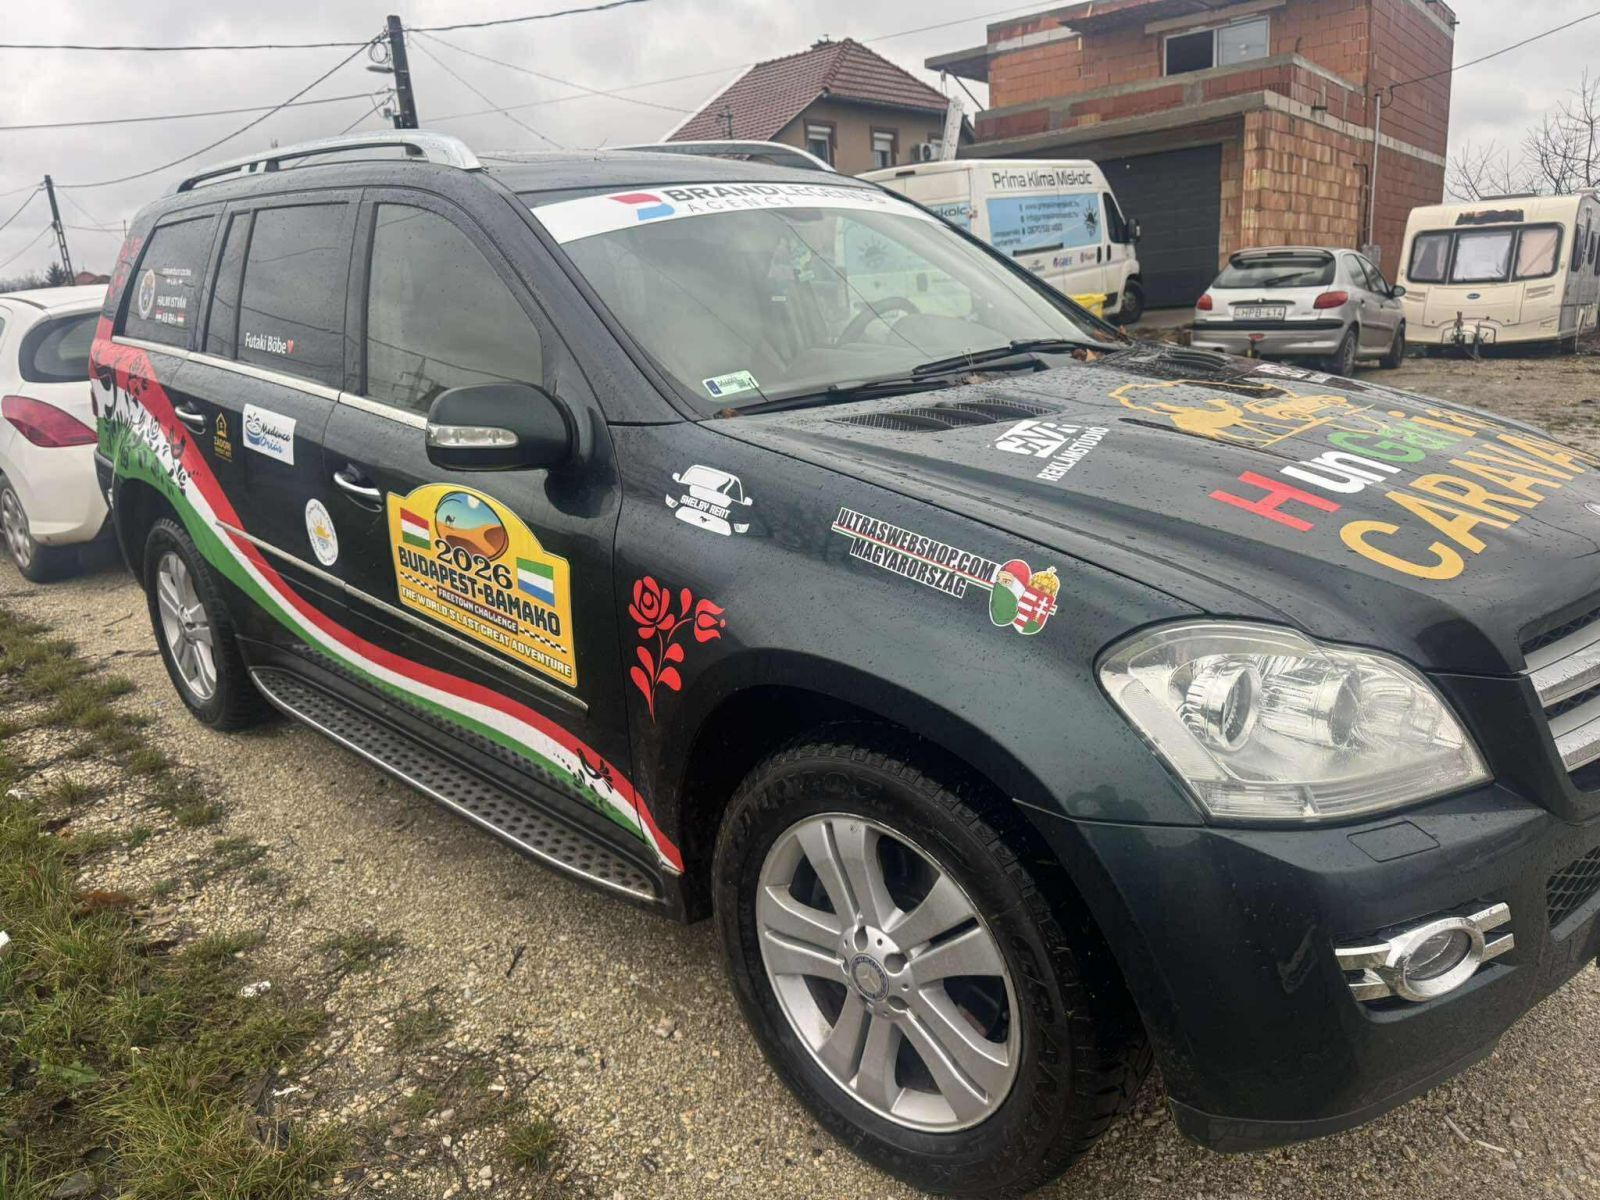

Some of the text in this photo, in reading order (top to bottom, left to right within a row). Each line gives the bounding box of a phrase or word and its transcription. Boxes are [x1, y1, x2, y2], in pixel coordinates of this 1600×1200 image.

[1056, 169, 1093, 187] Miskolc
[687, 196, 795, 214] AGENCY
[245, 332, 287, 354] Futaki Böbe
[680, 494, 731, 519] SHELBY RENT
[434, 539, 514, 590] 2026
[837, 508, 997, 582] ULTRASWEBSHOP.COM
[851, 537, 968, 597] MAGYARORSZÁG
[397, 545, 562, 637] BUDAPEST-BAMAKO
[438, 588, 518, 632] FREETOWN CHALLENGE
[401, 587, 573, 677] THE WORLD'S LAST GREAT ADVENTURE
